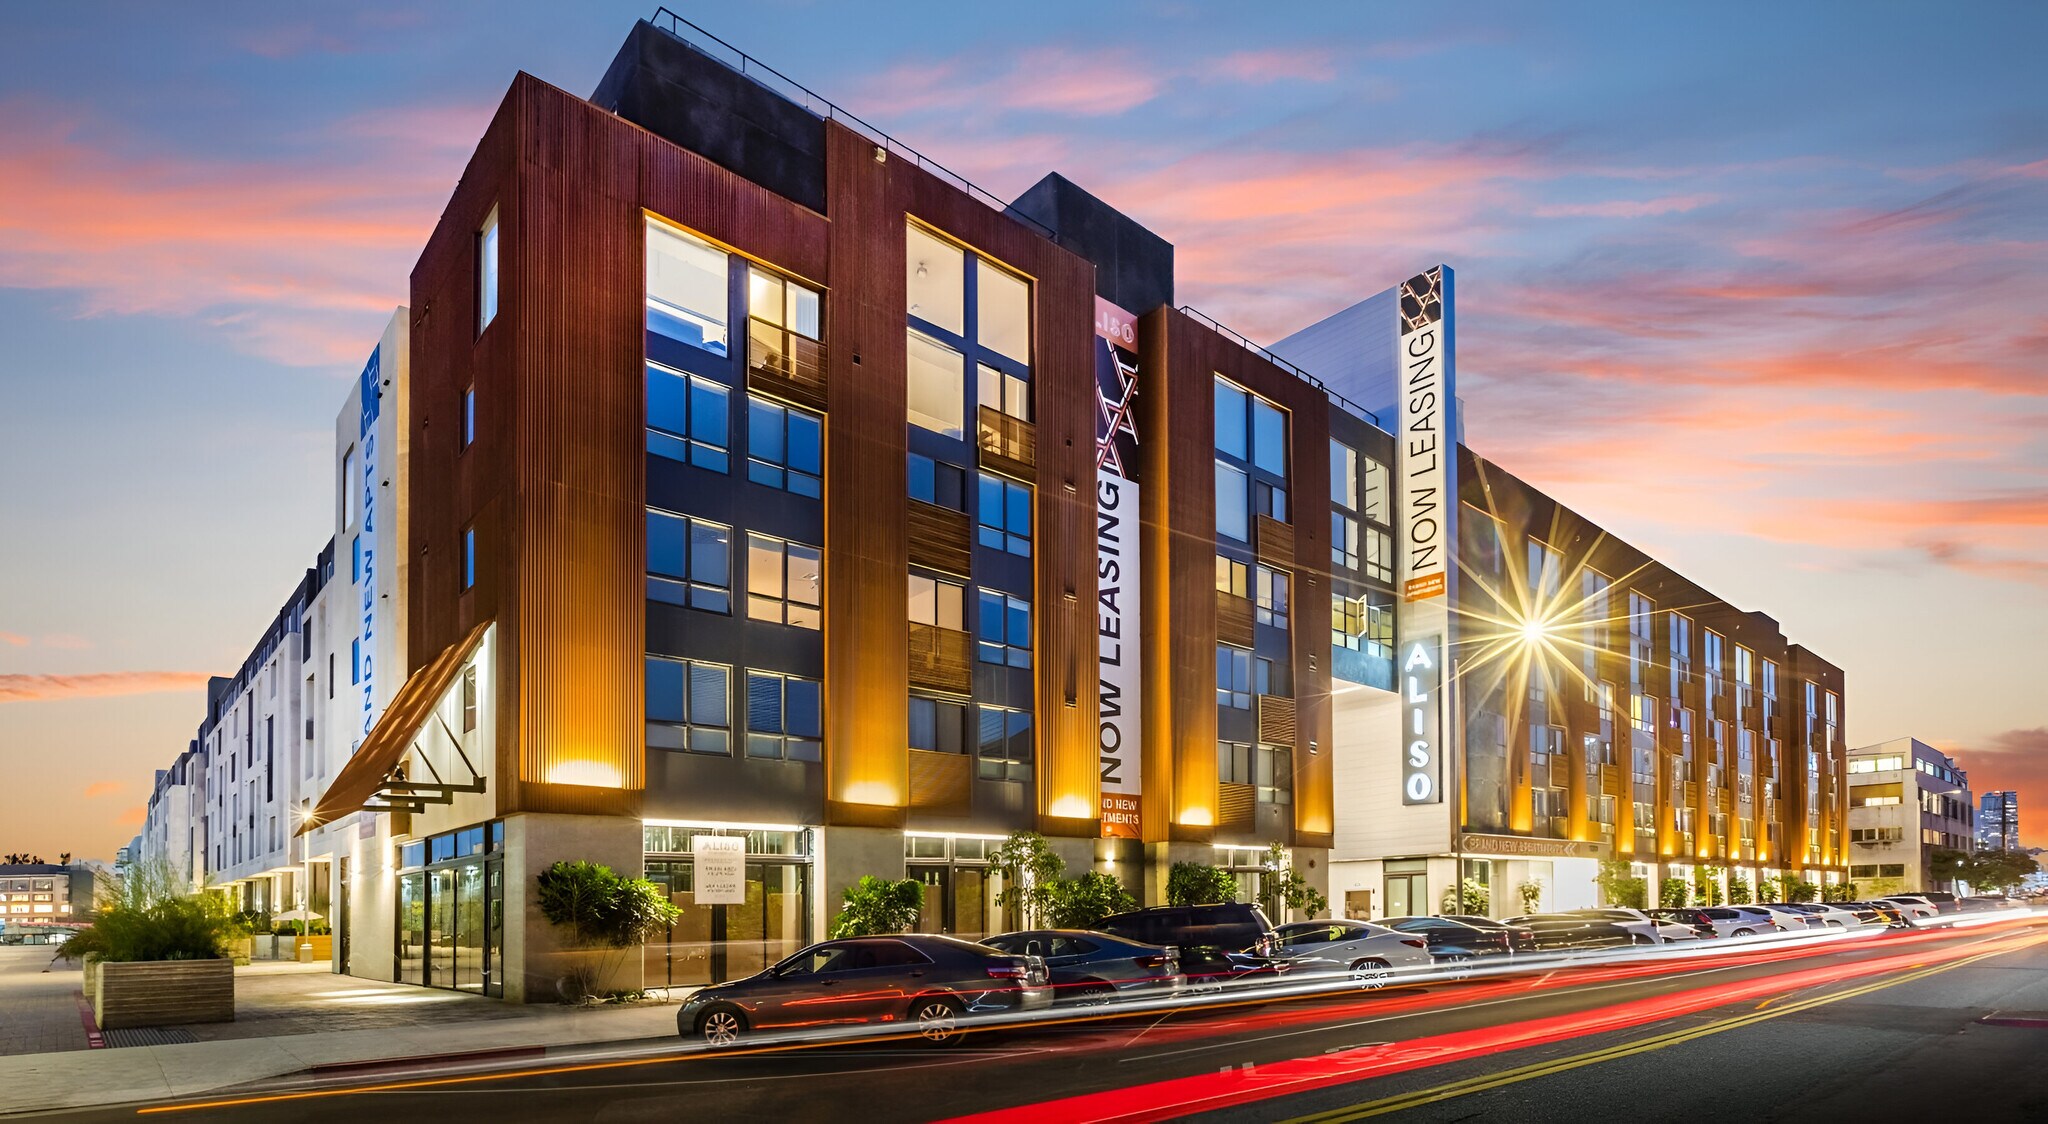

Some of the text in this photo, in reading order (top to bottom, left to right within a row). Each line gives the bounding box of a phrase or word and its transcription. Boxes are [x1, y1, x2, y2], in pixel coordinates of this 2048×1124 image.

[1096, 312, 1135, 344] ISO
[1408, 329, 1436, 477] LEASING
[1098, 480, 1121, 667] LEASING
[1410, 487, 1438, 572] NOW
[364, 433, 375, 736] AND NEW APTS
[1099, 679, 1122, 784] NOW
[1404, 642, 1433, 801] ALISO
[1103, 812, 1139, 825] TMENTS
[1115, 799, 1137, 811] NEW
